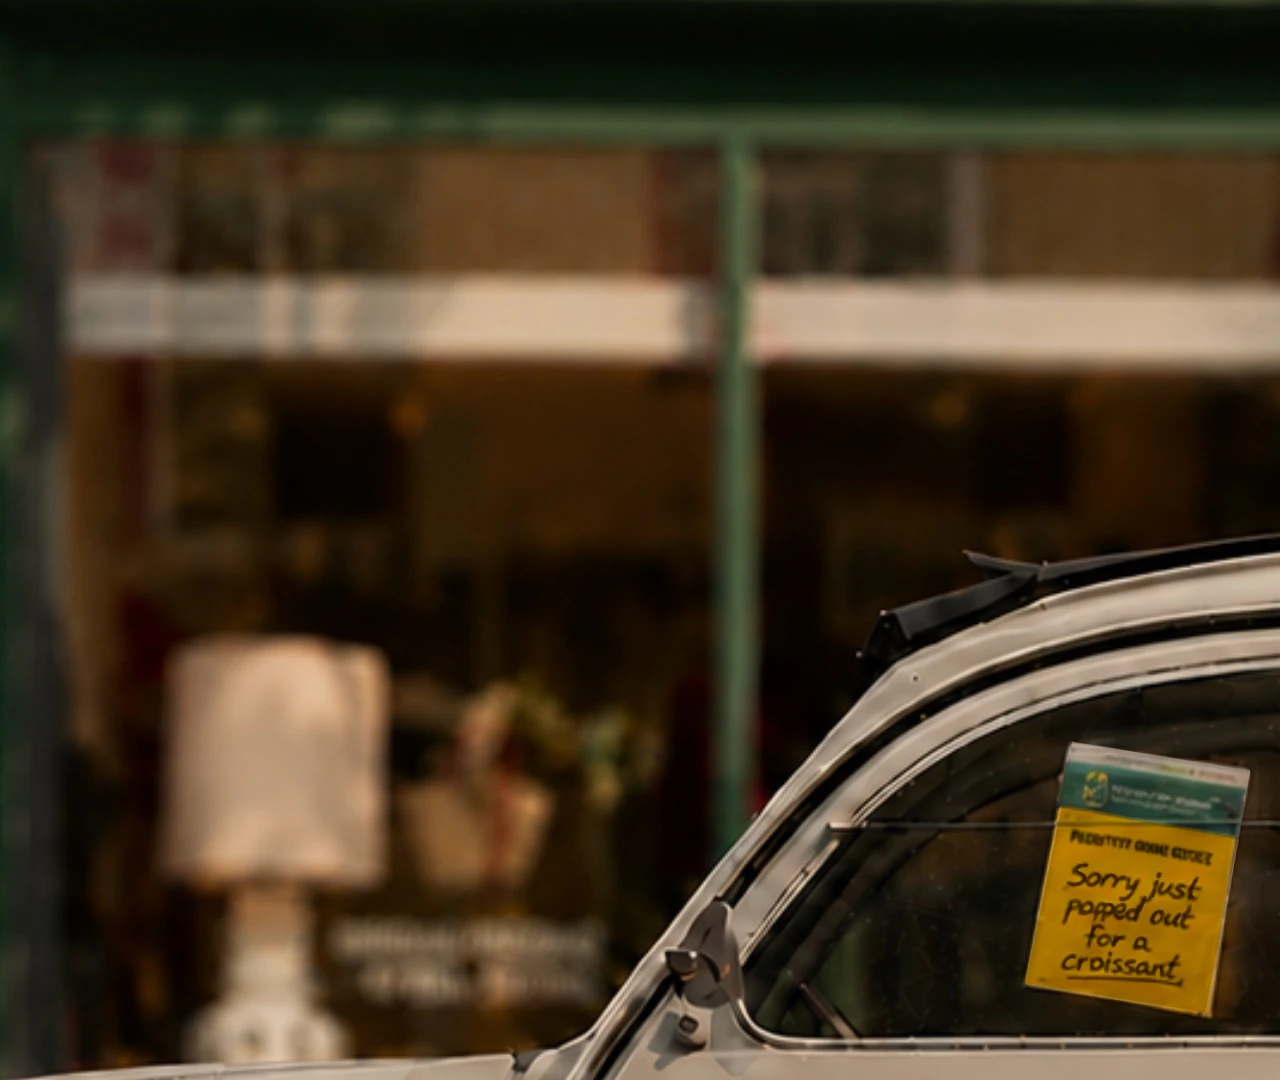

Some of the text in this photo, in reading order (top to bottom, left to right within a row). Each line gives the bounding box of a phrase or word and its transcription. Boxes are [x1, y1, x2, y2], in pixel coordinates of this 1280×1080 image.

[1066, 862, 1202, 903] Sorry just
[1062, 897, 1195, 930] popped out
[1083, 924, 1151, 951] for a
